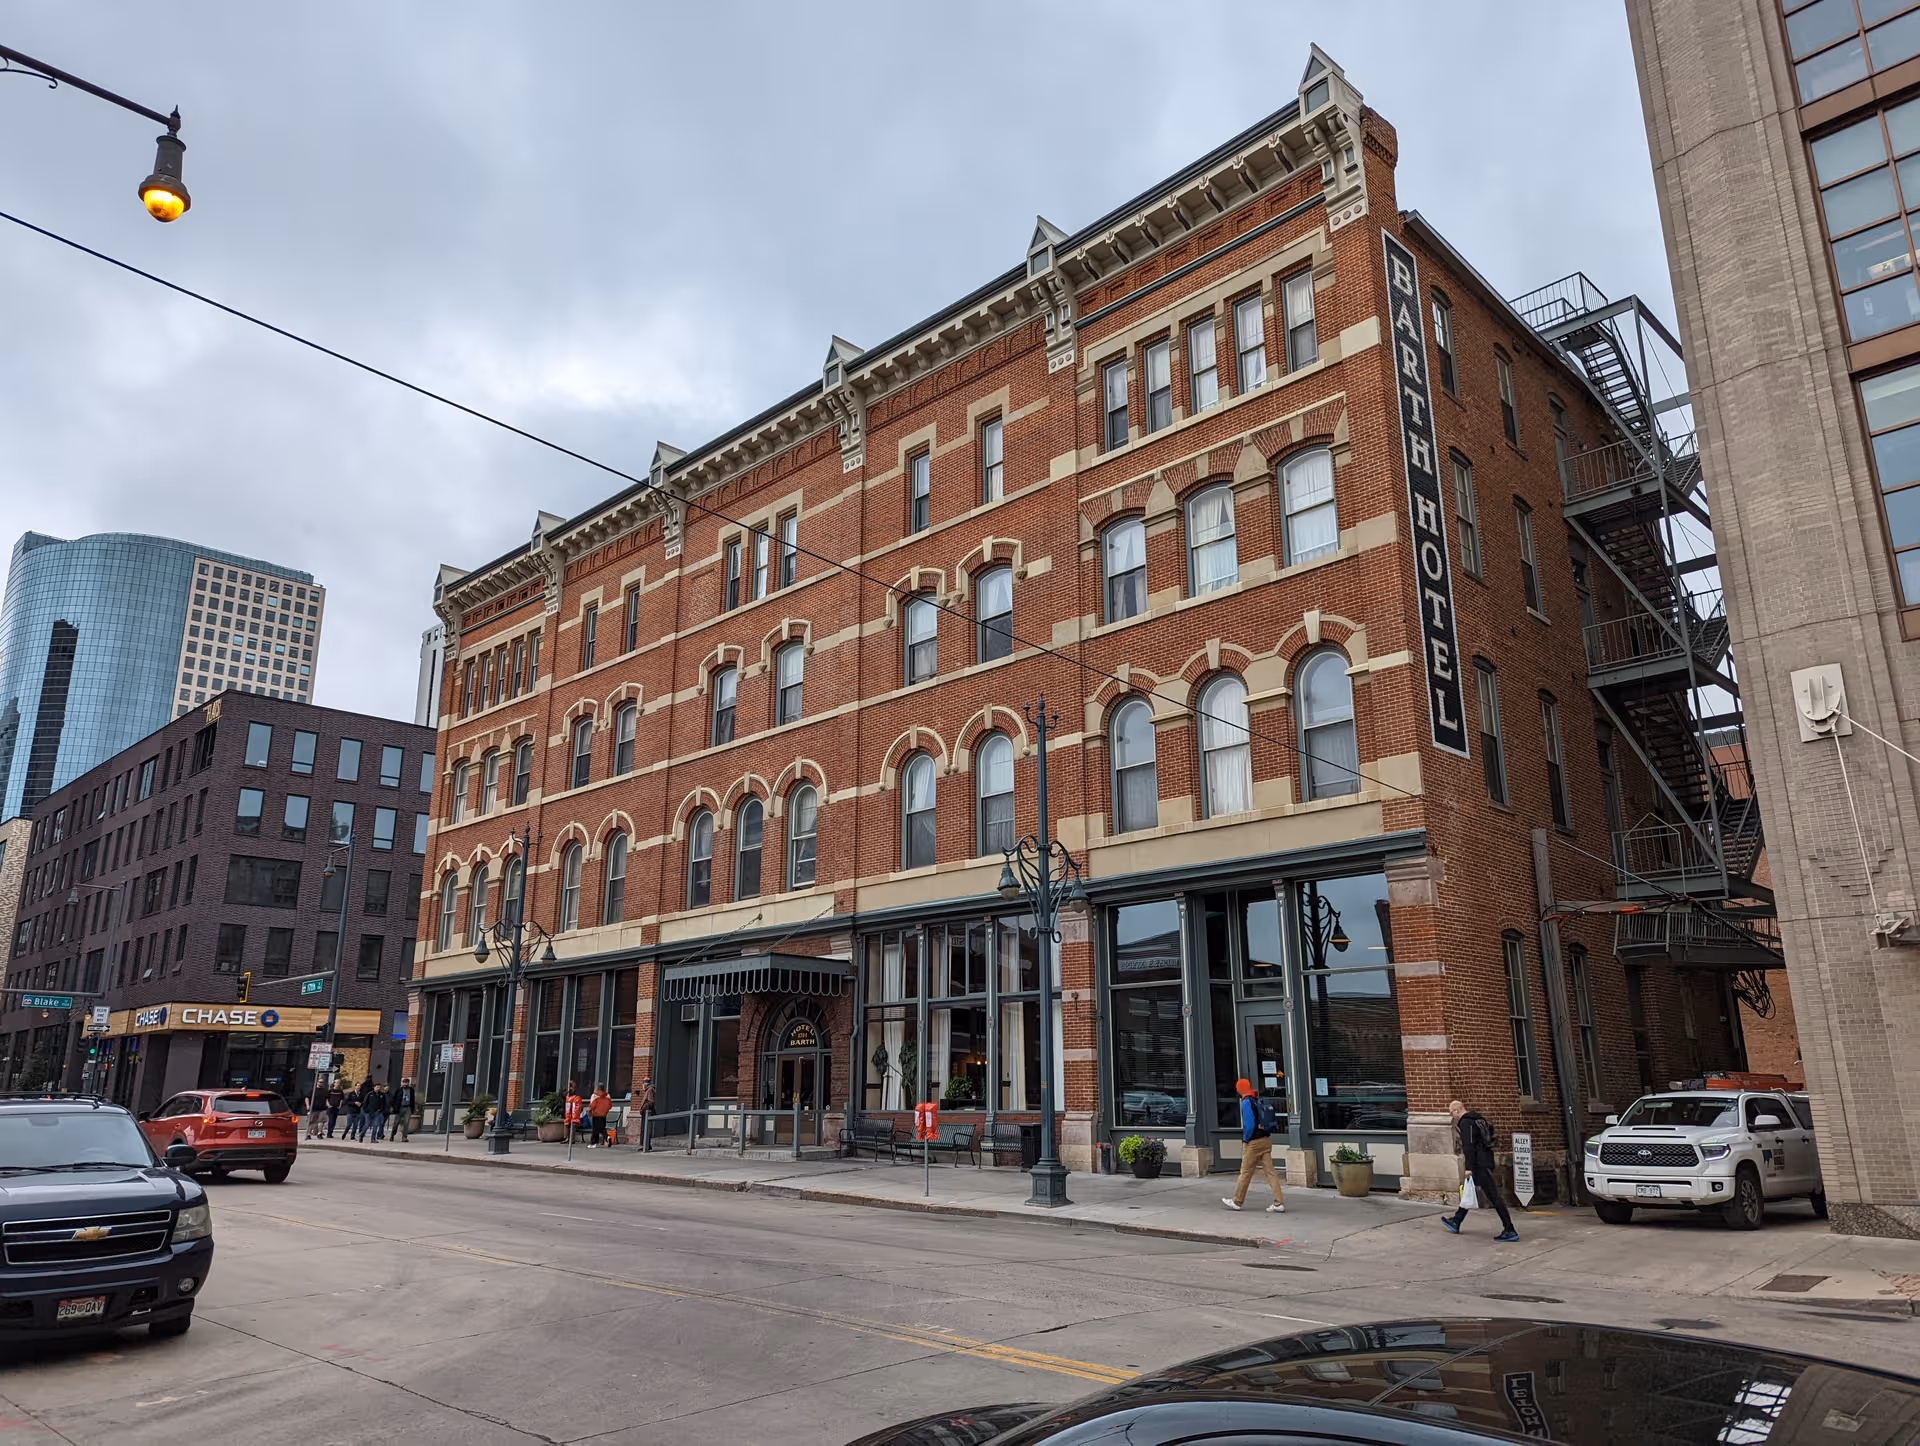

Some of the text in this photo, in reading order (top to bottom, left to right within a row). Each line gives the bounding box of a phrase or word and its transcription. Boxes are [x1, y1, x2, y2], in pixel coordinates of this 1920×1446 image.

[1391, 253, 1458, 733] BARTH HOTEL
[34, 997, 59, 1006] Blake
[135, 1009, 160, 1027] CHASE
[182, 1008, 258, 1026] CHASE
[791, 1025, 814, 1036] HOTEL
[58, 1304, 77, 1316] 269
